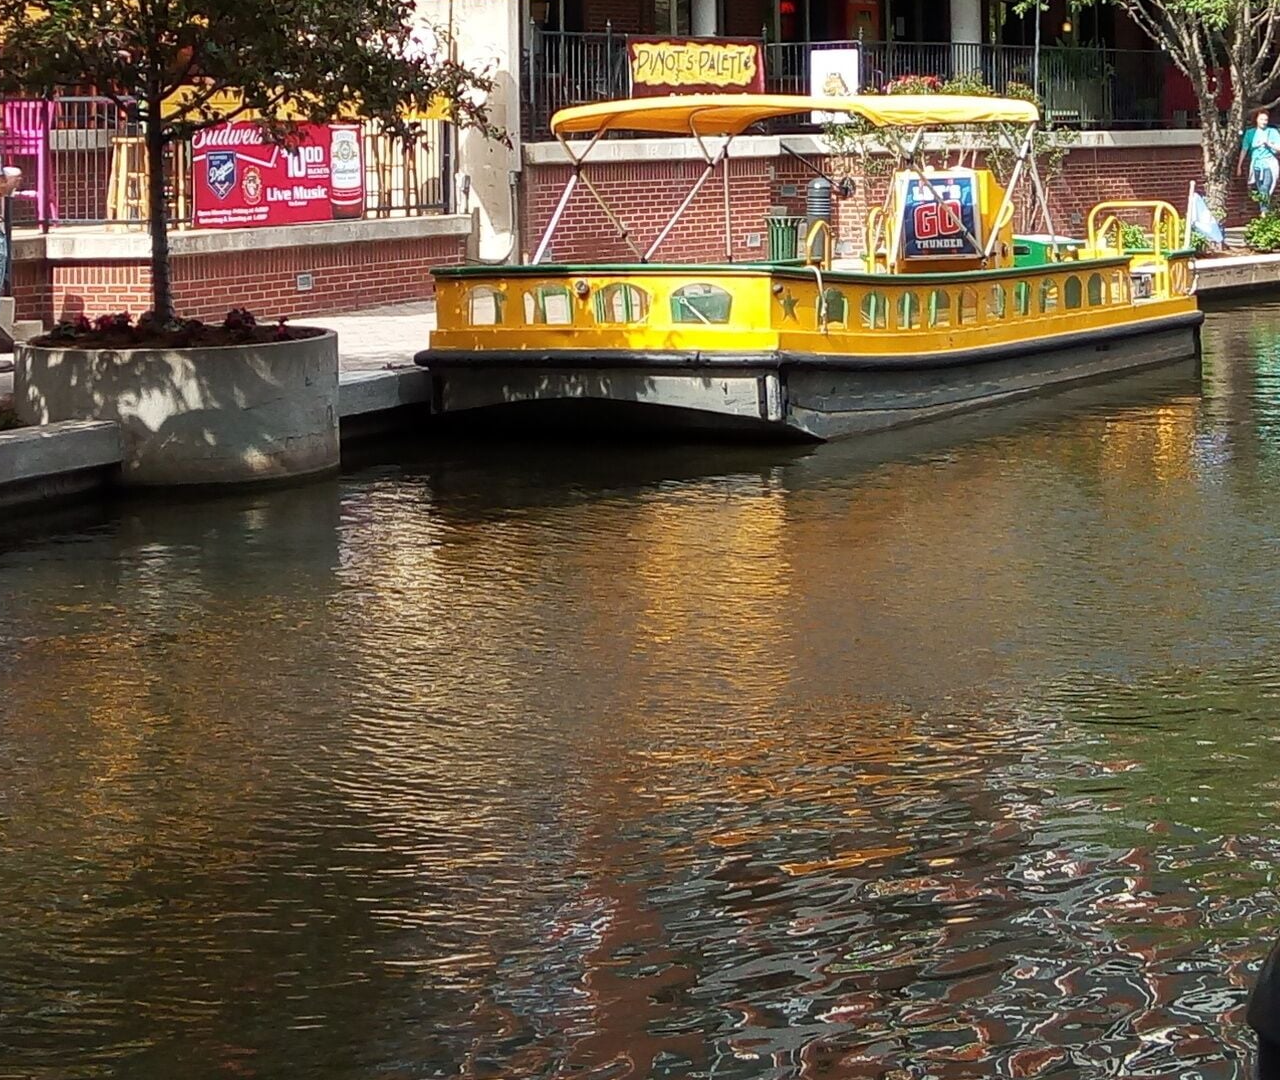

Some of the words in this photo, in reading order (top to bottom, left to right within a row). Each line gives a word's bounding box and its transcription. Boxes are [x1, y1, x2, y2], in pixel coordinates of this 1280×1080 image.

[636, 49, 695, 77] PINOT'S
[266, 187, 291, 201] Live
[293, 185, 328, 200] Music
[914, 200, 962, 239] GO
[915, 238, 963, 249] THUNDER
